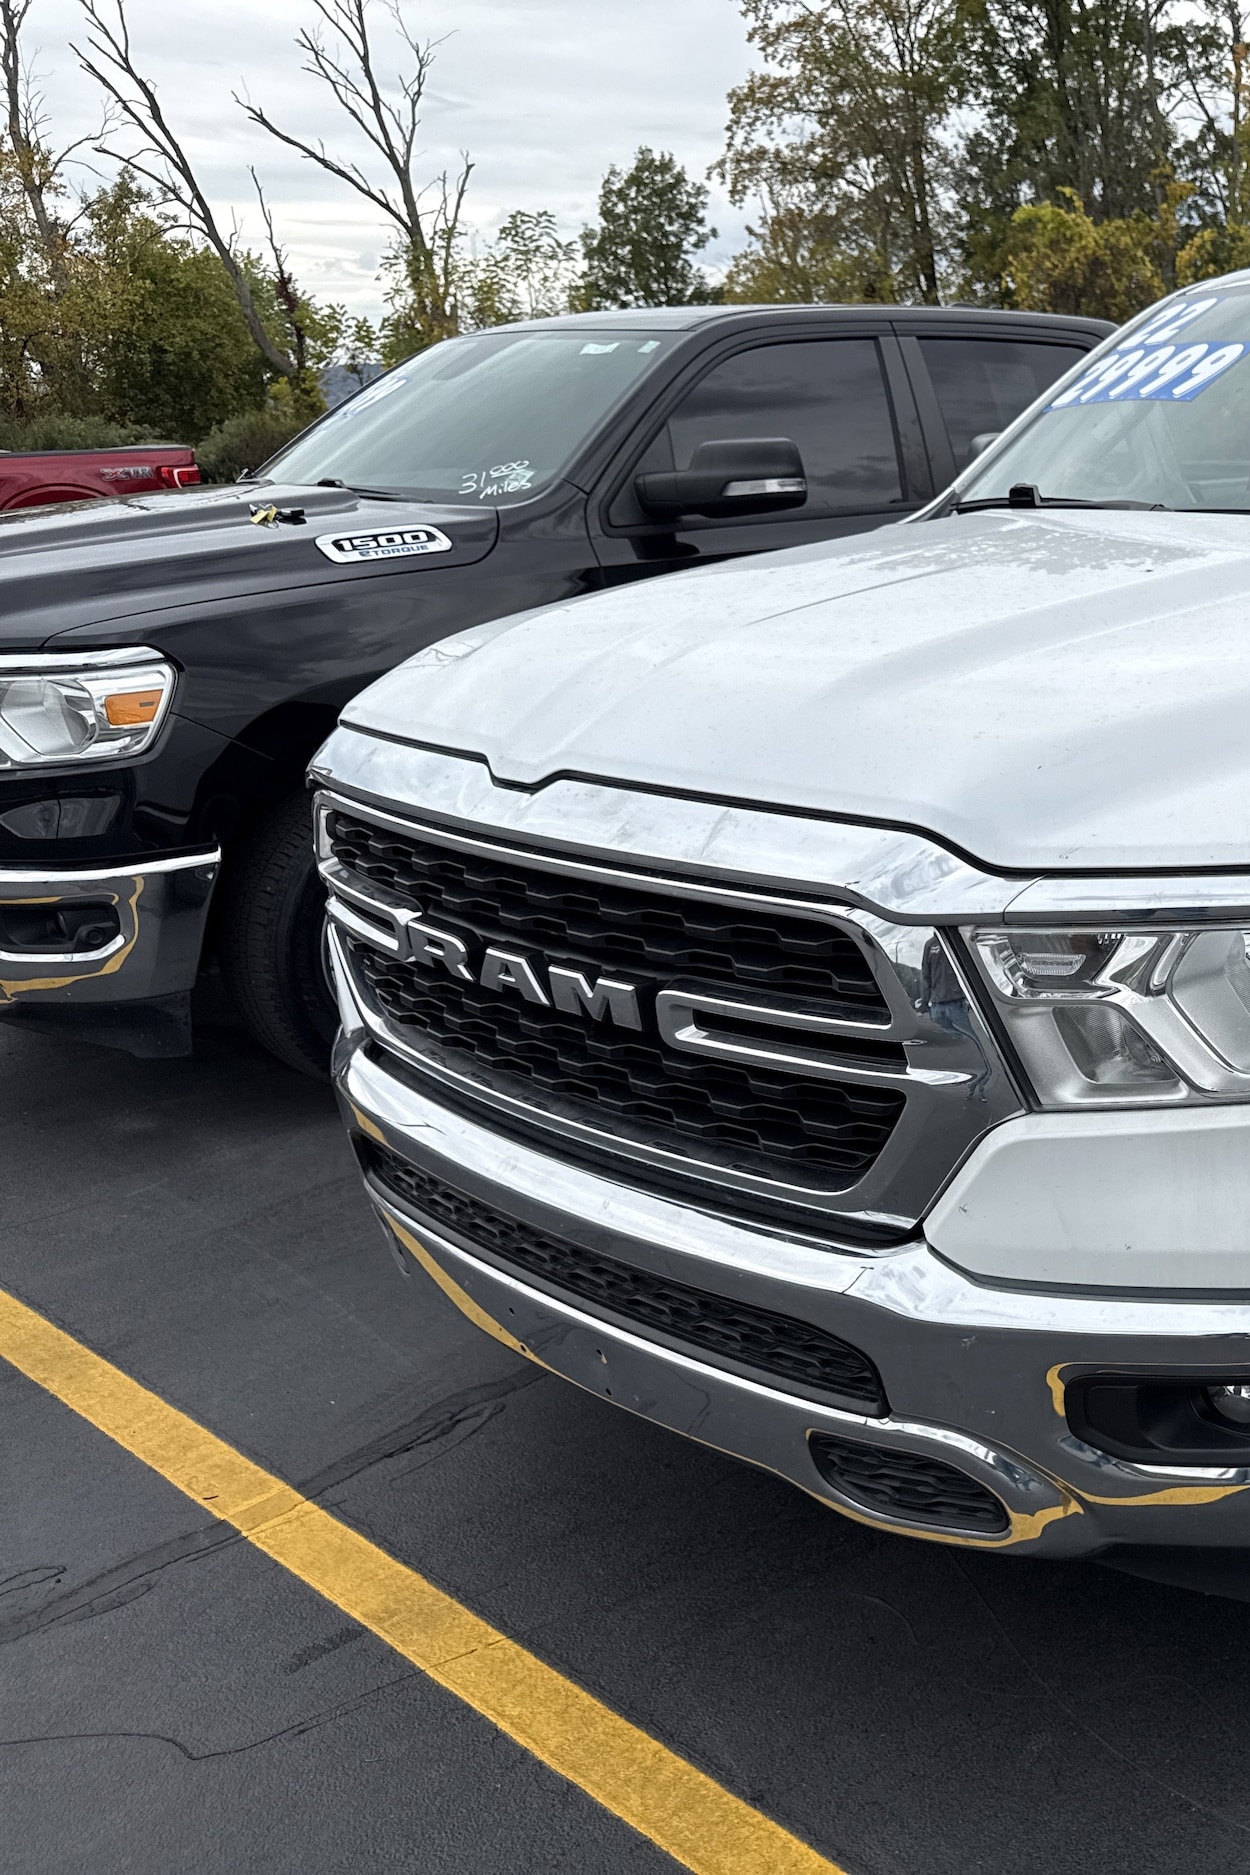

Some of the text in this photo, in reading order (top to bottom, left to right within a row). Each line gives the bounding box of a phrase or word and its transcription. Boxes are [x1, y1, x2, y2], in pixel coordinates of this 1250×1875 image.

[1050, 344, 1244, 408] 29999
[100, 466, 153, 482] XTR
[338, 531, 429, 551] 1500
[407, 918, 643, 1032] RAM
